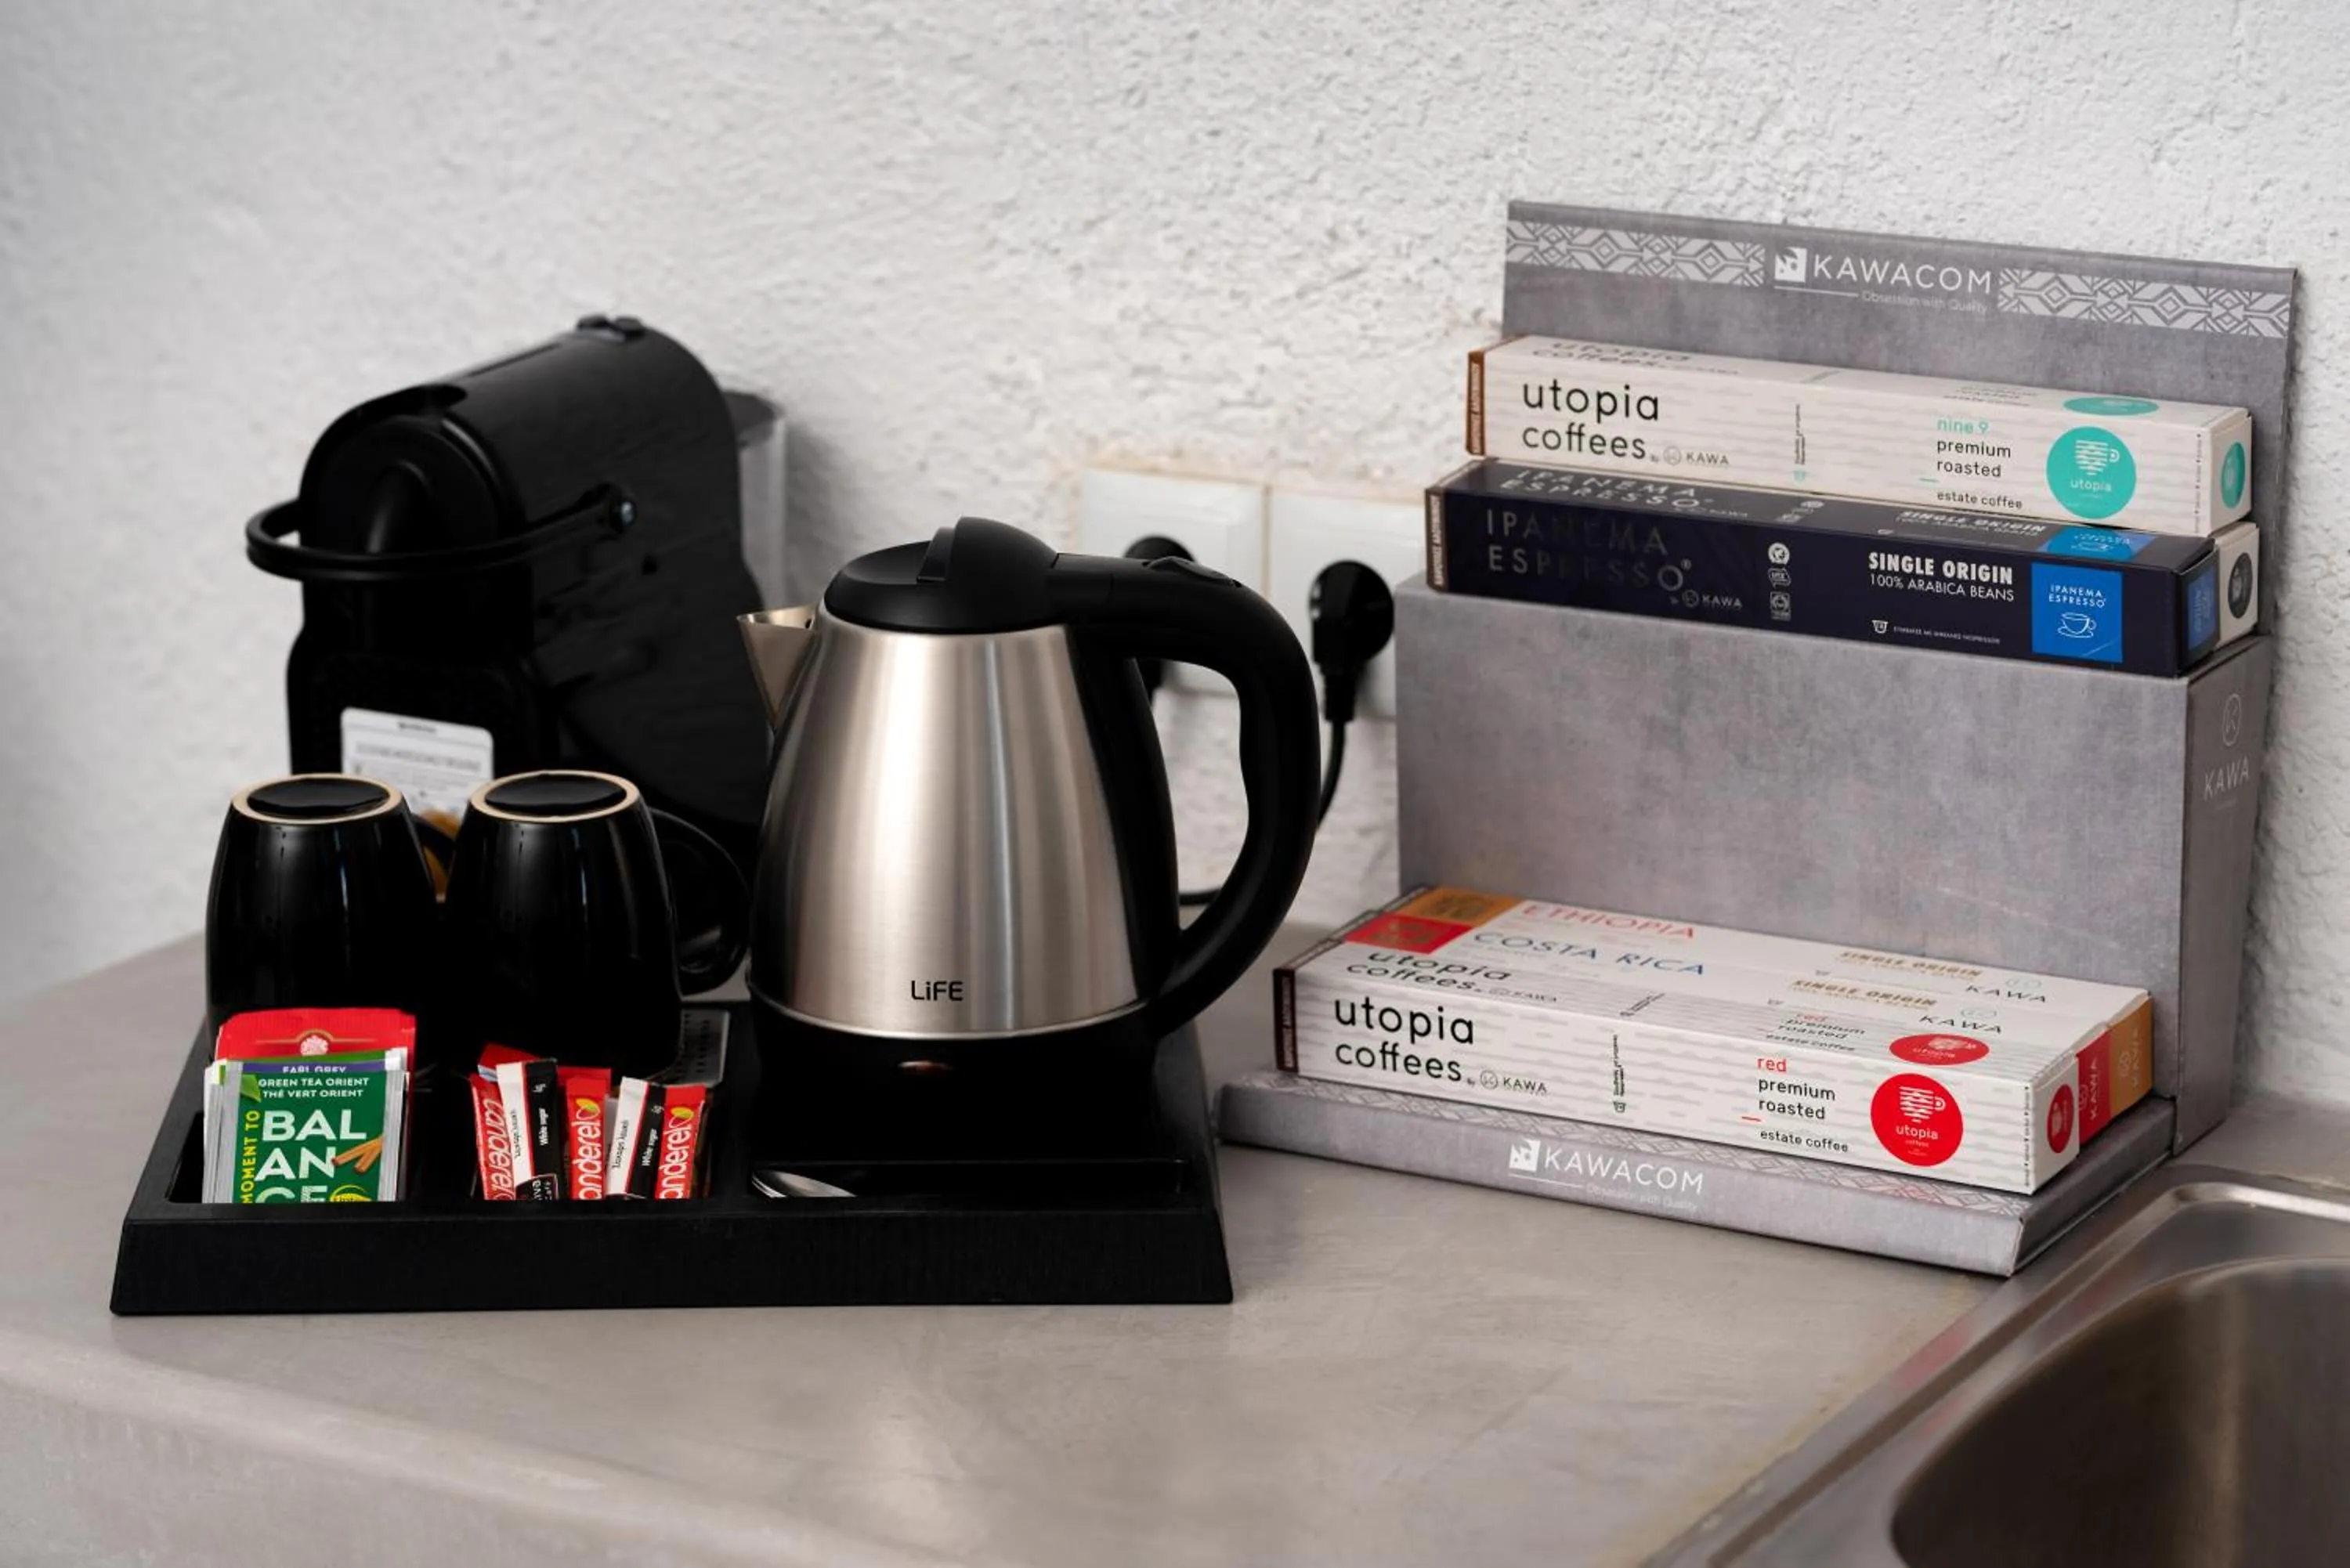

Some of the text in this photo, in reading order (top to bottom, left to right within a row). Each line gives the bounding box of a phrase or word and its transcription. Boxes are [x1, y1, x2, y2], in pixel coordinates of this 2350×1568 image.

[1813, 253, 1992, 294] KAWACOM
[1523, 378, 1659, 425] utopia
[1936, 418, 1990, 435] nine 9
[1522, 421, 1646, 460] coffees
[1686, 452, 1730, 466] KAWA
[1936, 439, 2012, 458] premium
[1517, 469, 1695, 497] IPANEMA
[1936, 461, 2003, 478] roasted
[1499, 479, 1701, 508] ESPRESSO
[1936, 491, 2023, 509] estate coffee
[2070, 479, 2113, 493] utopia
[1868, 551, 2013, 586] SINGLE ORIGIN
[1701, 593, 1744, 609] KAWA
[1870, 573, 2015, 602] 100% ARABICA BEANS
[2048, 593, 2106, 609] ESPRESSO
[2050, 583, 2103, 598] IPANEMA
[2203, 755, 2250, 802] KAWA
[1523, 904, 1694, 939] ETHIOPIA
[1368, 952, 1512, 981] utopia
[1474, 931, 1597, 959] COSTA
[1615, 952, 1704, 976] RICA
[1347, 963, 1476, 991] coffees
[1965, 983, 2047, 1004] KAWA
[1334, 995, 1474, 1045] utopia
[1918, 1013, 2002, 1035] KAWA
[1335, 1040, 1462, 1082] coffees
[1502, 1076, 1549, 1094] KAWA
[1756, 1057, 1787, 1073] red
[258, 1077, 370, 1088] GREEN TEA ORIENT
[262, 1088, 364, 1099] THÉ VERT ORIENT
[1758, 1078, 1835, 1101] premium
[1758, 1100, 1826, 1120] roasted
[262, 1108, 367, 1142] BAL
[1895, 1124, 1939, 1140] utopia
[482, 1097, 515, 1196] canderel
[1759, 1130, 1849, 1153] estate coffee
[240, 1109, 261, 1204] MOMENT TO
[254, 1146, 336, 1182] AN
[571, 1119, 602, 1201] anderel
[658, 1123, 692, 1199] anderel
[1544, 1146, 1705, 1196] KAWACOM
